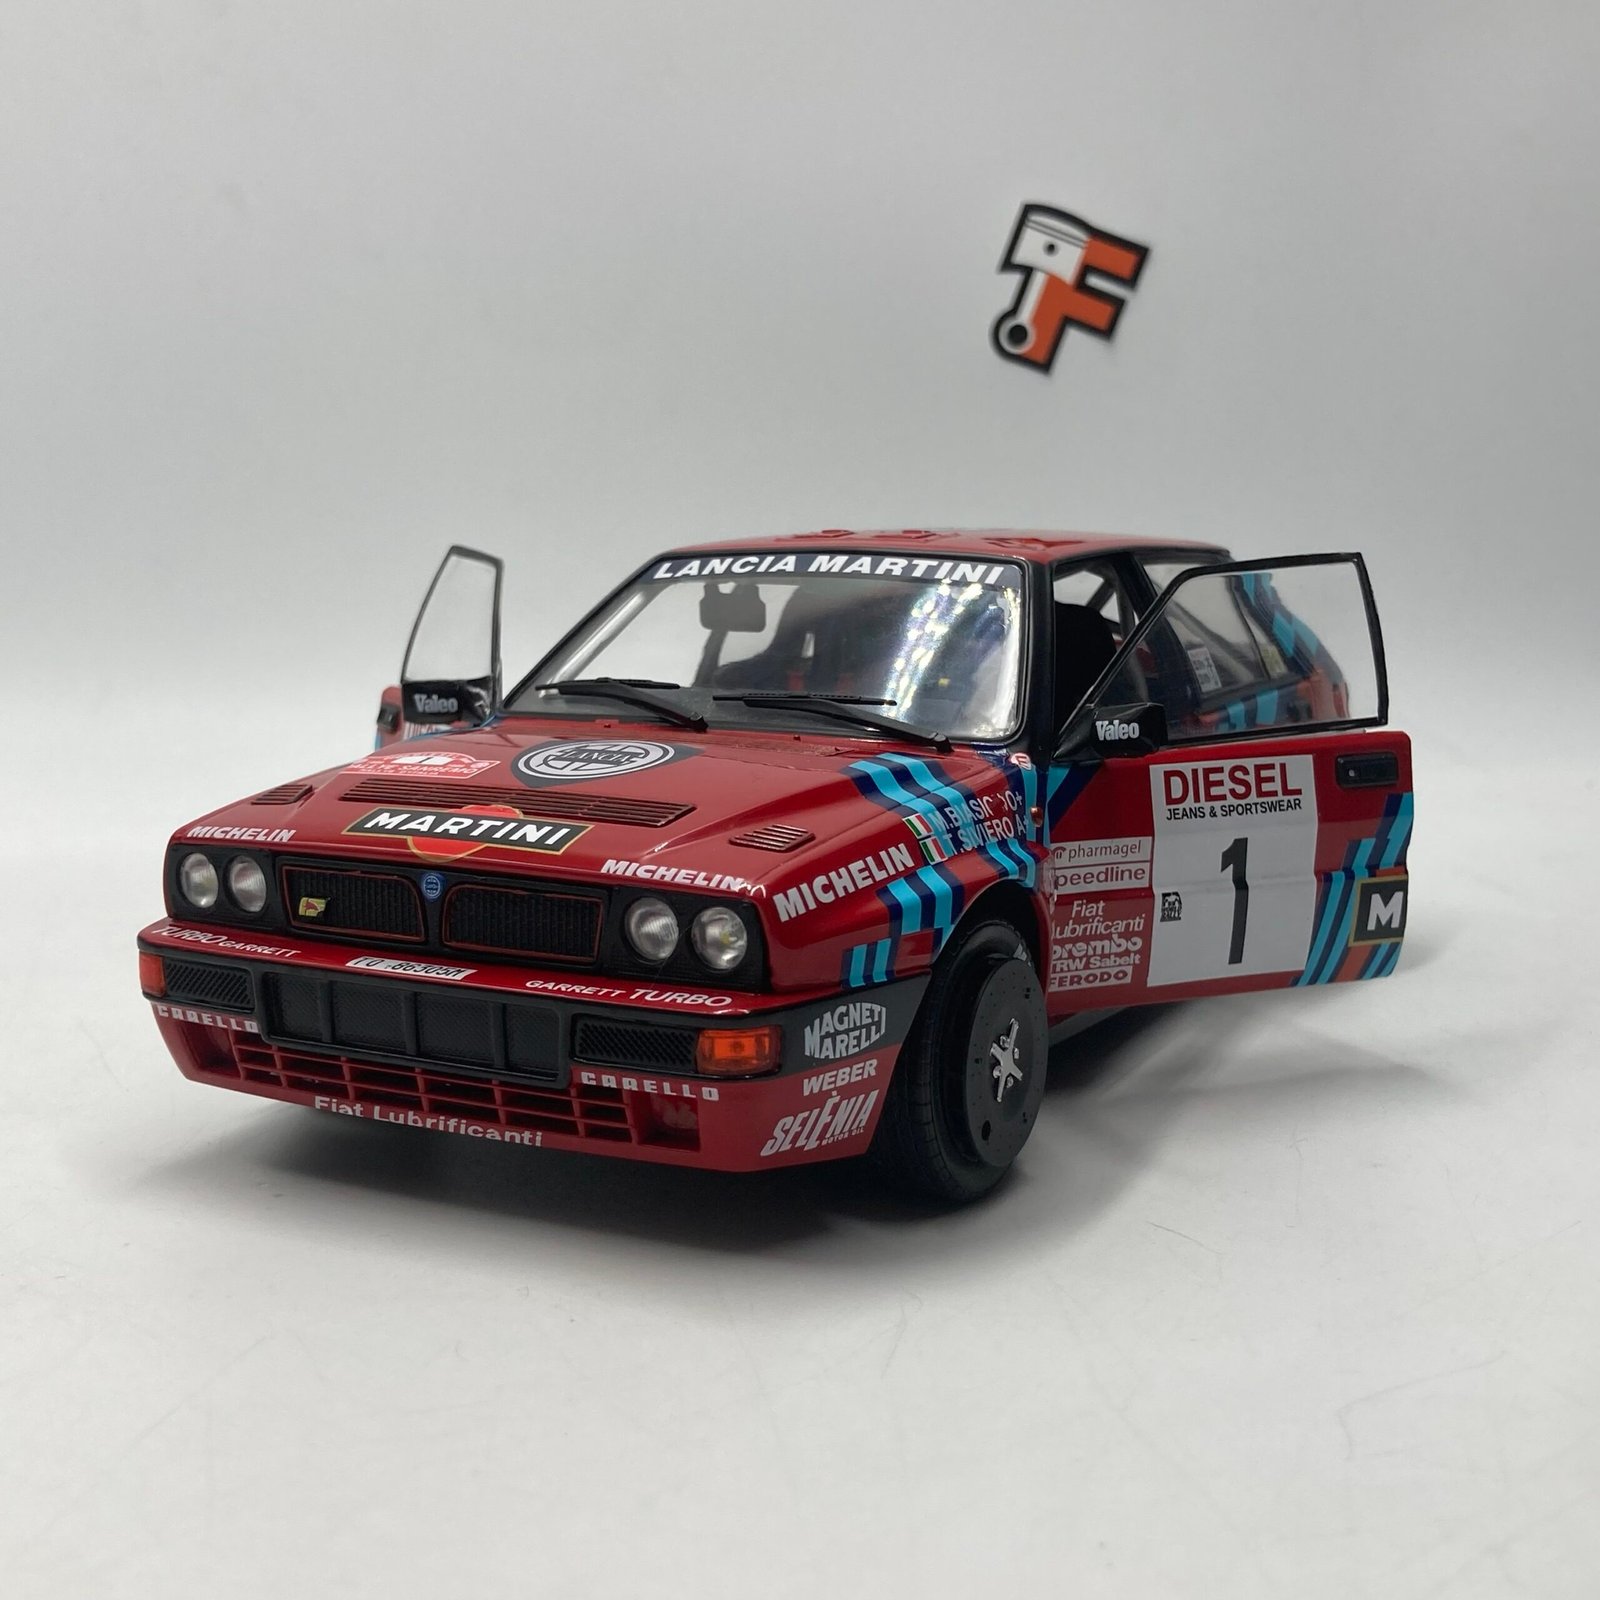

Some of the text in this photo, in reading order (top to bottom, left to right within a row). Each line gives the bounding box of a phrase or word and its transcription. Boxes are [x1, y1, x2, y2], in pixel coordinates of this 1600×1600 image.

[653, 555, 1005, 585] LANCIA MARTINI
[414, 692, 459, 713] Valeo
[1095, 719, 1140, 741] Valeo
[1163, 762, 1303, 806] DIESEL
[1166, 798, 1302, 821] JEANS & SPORTSWEAR
[186, 826, 297, 843] MICHELIN
[364, 811, 573, 845] MARTINI
[1068, 840, 1142, 862] pharmagel
[600, 859, 746, 892] MICHELIN
[772, 842, 915, 923] MICHELIN
[1055, 866, 1146, 890] peedline
[1071, 900, 1106, 918] Fiat
[1220, 837, 1249, 965] 1
[1367, 891, 1404, 931] M
[152, 925, 302, 957] TURBO GARRETT
[1089, 953, 1141, 970] Sabelt
[525, 980, 733, 1007] GARRETT TURBO
[1050, 969, 1129, 988] FERODO
[156, 1004, 260, 1034] CARELLO
[804, 1002, 887, 1050] MAGNETI
[580, 1071, 720, 1101] CARELLO
[803, 1058, 878, 1097] WEBER
[314, 1095, 543, 1147] Fiat Lubrificanti
[851, 1126, 865, 1137] OIL
